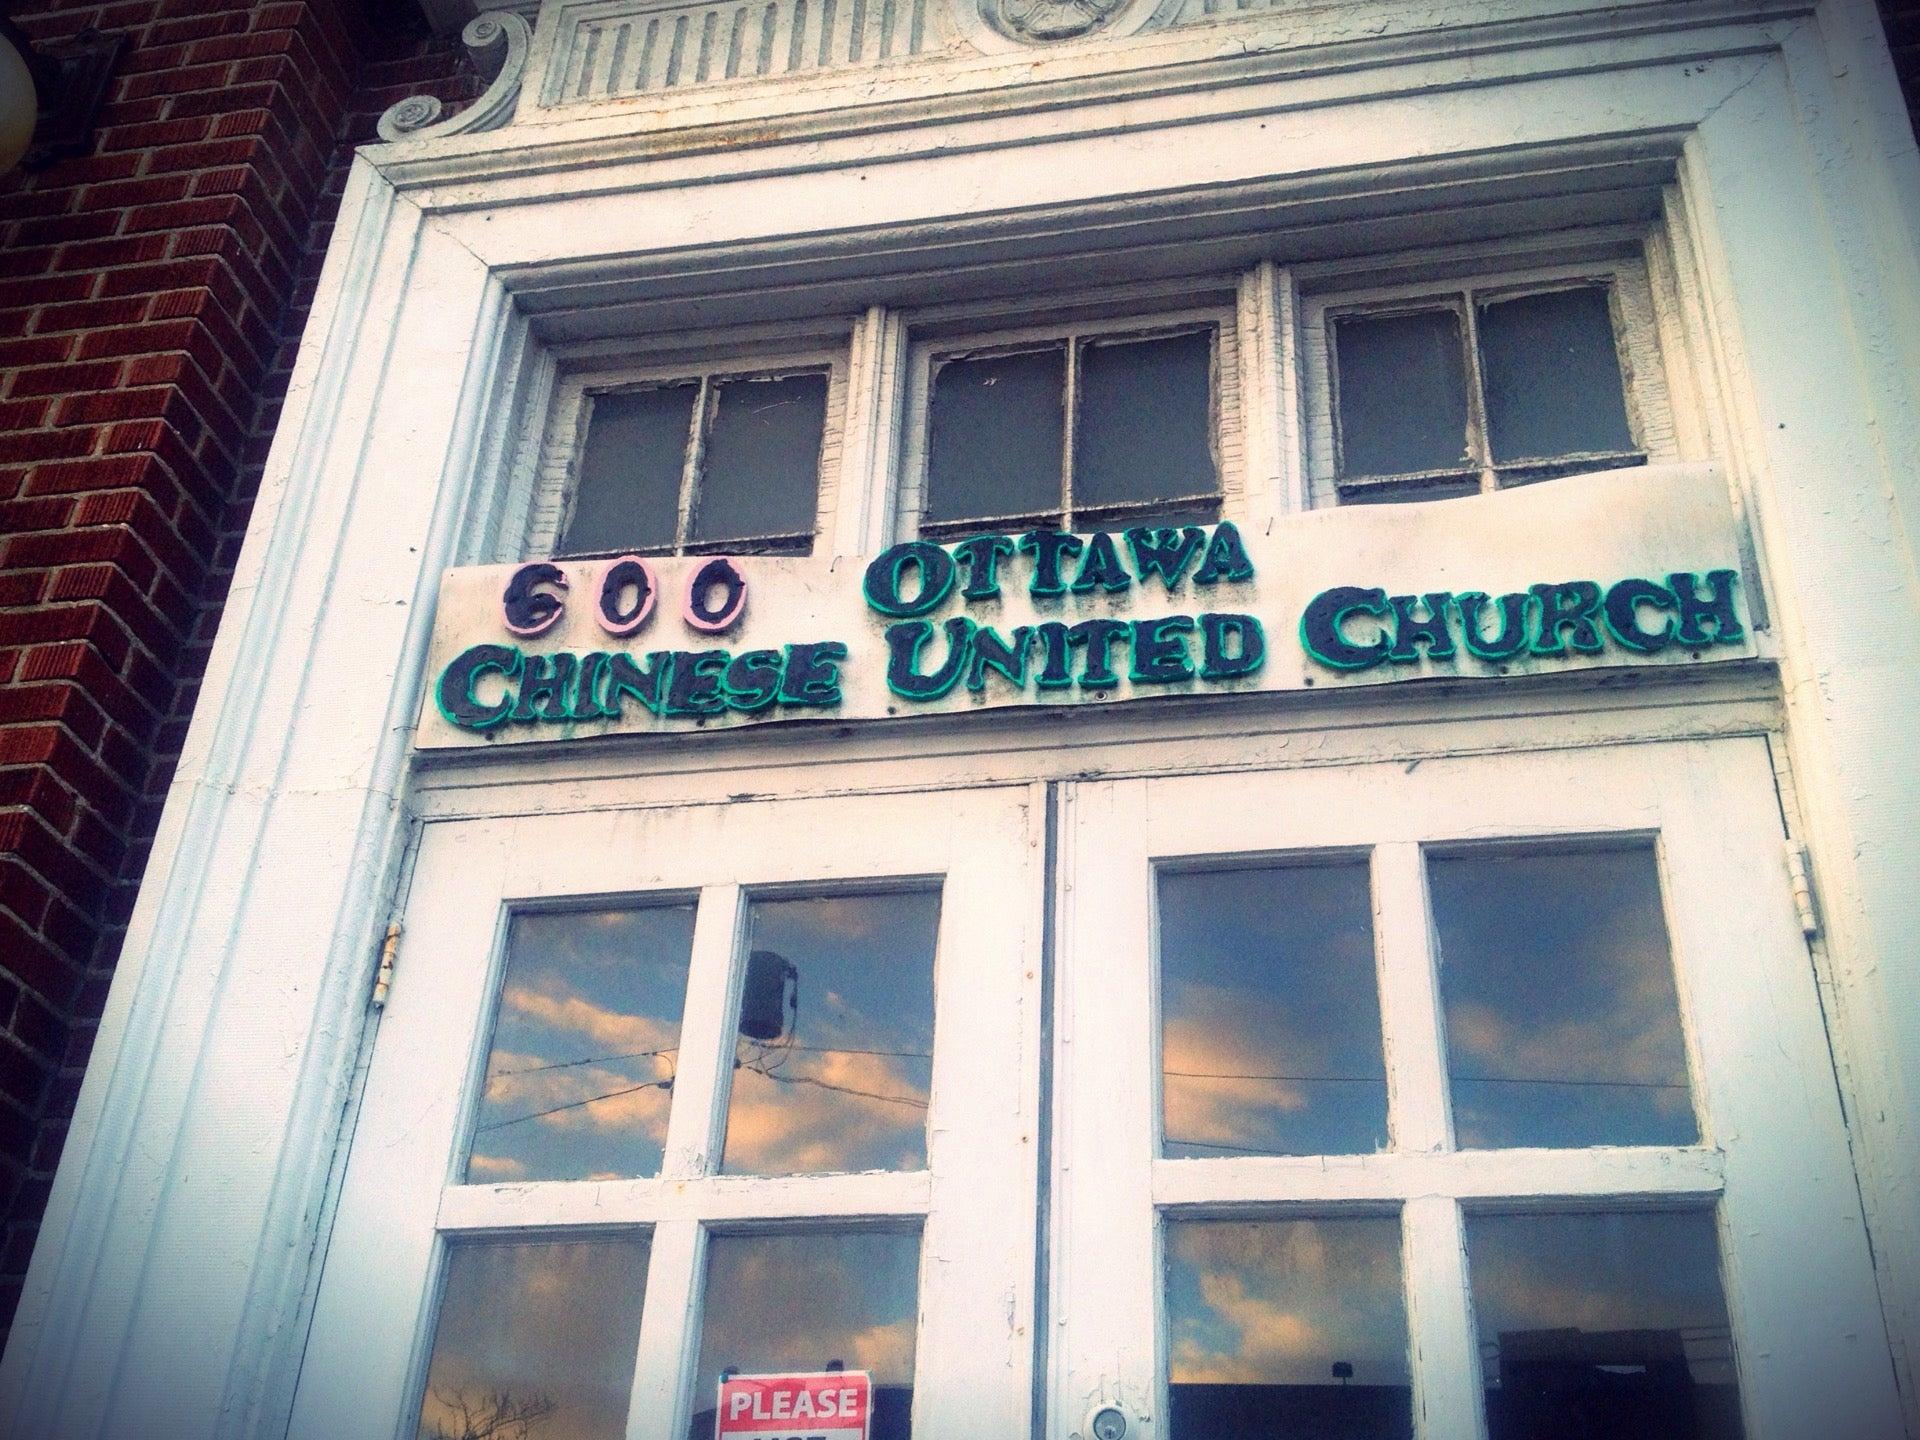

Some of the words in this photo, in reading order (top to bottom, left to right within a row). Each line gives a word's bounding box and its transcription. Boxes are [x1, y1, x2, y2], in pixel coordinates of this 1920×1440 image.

[502, 555, 748, 638] 600
[863, 520, 1255, 617] OTTAWA
[435, 641, 847, 730] CHINESE
[886, 612, 1265, 702] UNITED
[1299, 569, 1745, 670] CHURCH
[729, 1388, 858, 1421] PLEASE
